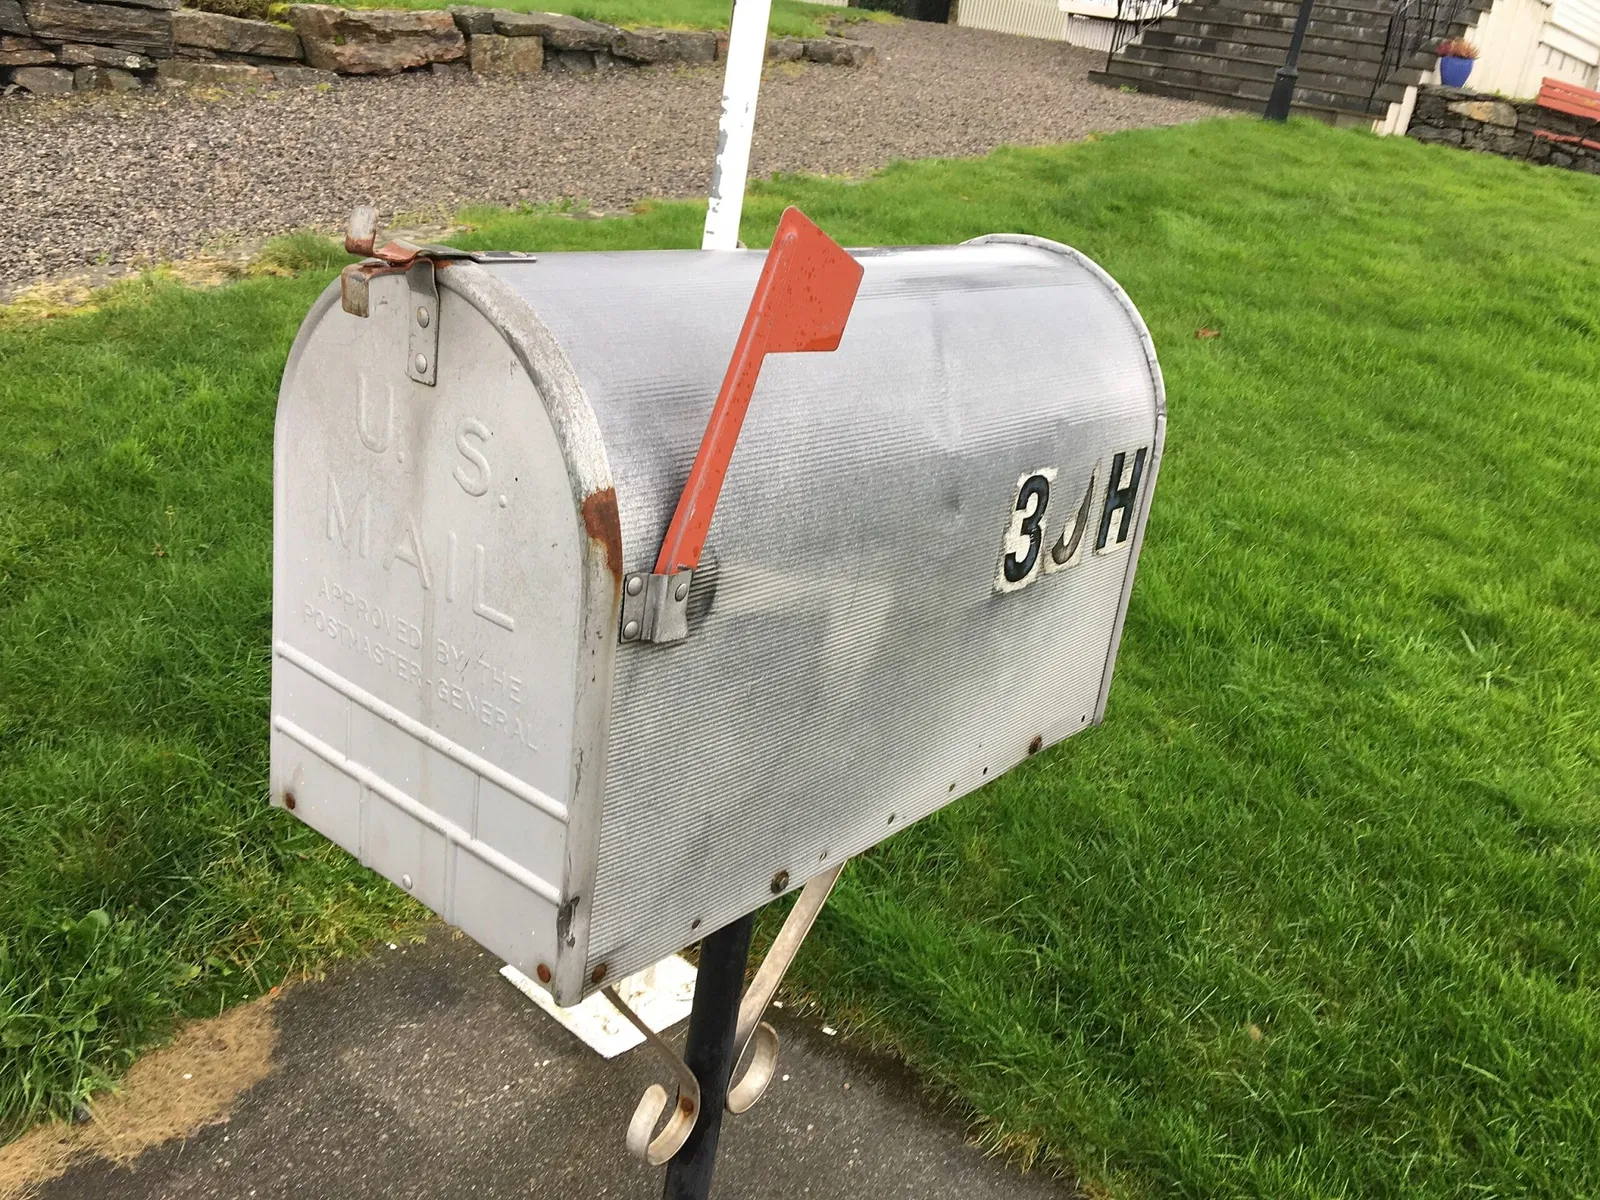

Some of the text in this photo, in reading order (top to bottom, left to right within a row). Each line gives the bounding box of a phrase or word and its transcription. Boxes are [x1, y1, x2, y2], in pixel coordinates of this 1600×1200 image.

[326, 473, 516, 632] MAIL
[318, 576, 524, 704] APPROVED BY THE
